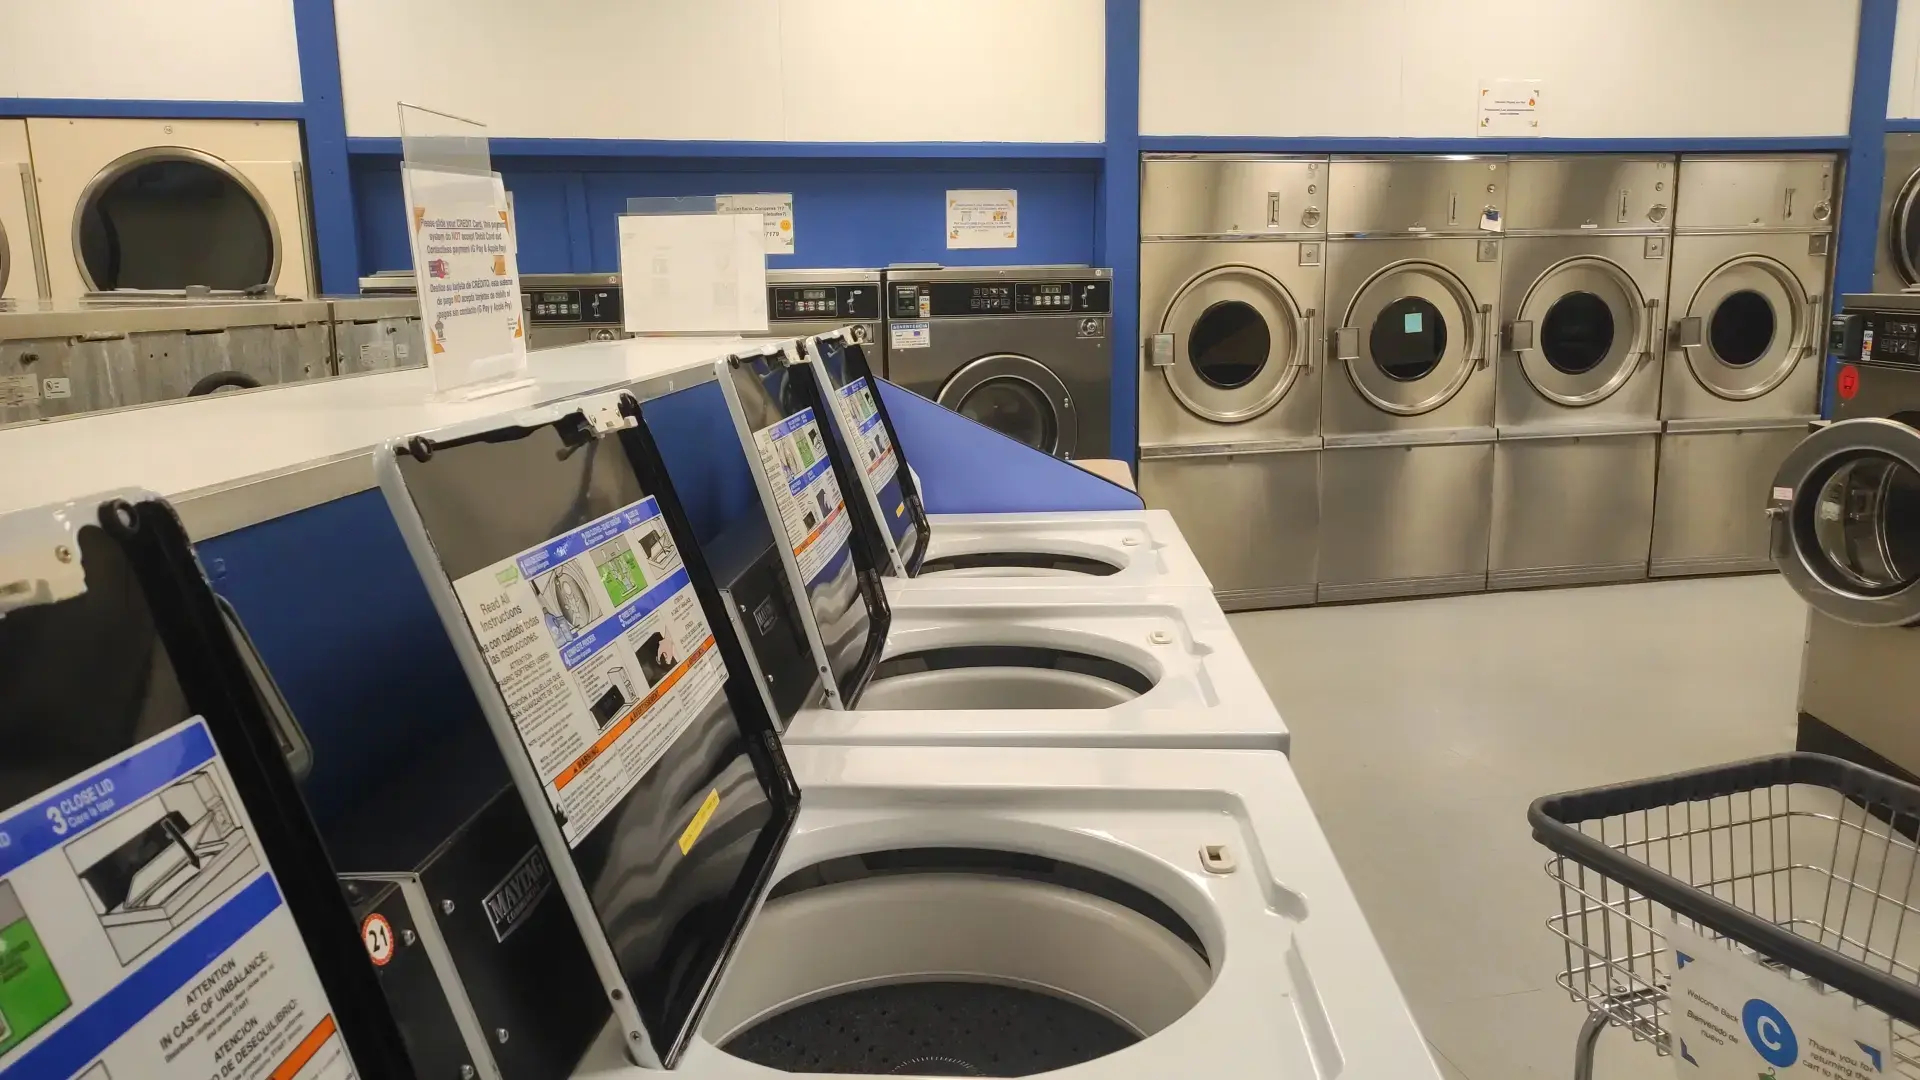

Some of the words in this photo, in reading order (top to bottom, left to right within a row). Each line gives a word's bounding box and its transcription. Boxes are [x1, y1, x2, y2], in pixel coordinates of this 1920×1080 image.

[451, 232, 460, 240] NOT
[456, 219, 472, 227] CREDIT
[479, 594, 501, 616] Read
[499, 591, 511, 606] All
[480, 605, 523, 633] Instructions
[501, 623, 525, 643] cuidado
[523, 615, 540, 632] todas
[488, 652, 501, 666] las
[60, 786, 98, 815] CLOSE
[94, 778, 115, 797] LID
[46, 806, 68, 835] 3
[488, 853, 543, 924] MAYTAG
[368, 925, 388, 953] 21
[185, 957, 236, 1006] ATTENTION
[159, 1032, 173, 1051] IN
[172, 1008, 201, 1039] CASE
[200, 996, 215, 1015] OF
[214, 950, 268, 1002] UNBALANCE:
[1687, 987, 1719, 1012] Welcome
[1720, 1007, 1739, 1024] Back
[214, 1016, 258, 1063] ATENCIÓN
[220, 1058, 235, 1078] DE
[234, 999, 298, 1064] DESEQUILIBRIO:
[1687, 1009, 1727, 1037] Bienvenido
[1728, 1033, 1739, 1045] de
[1701, 1029, 1724, 1046] nuevo
[1757, 1015, 1781, 1051] C
[1802, 1060, 1820, 1073] cart
[1821, 1068, 1832, 1078] to
[1808, 1037, 1837, 1057] Thank
[1839, 1054, 1858, 1067] you
[1859, 1061, 1874, 1073] for
[1810, 1052, 1853, 1077] returning
